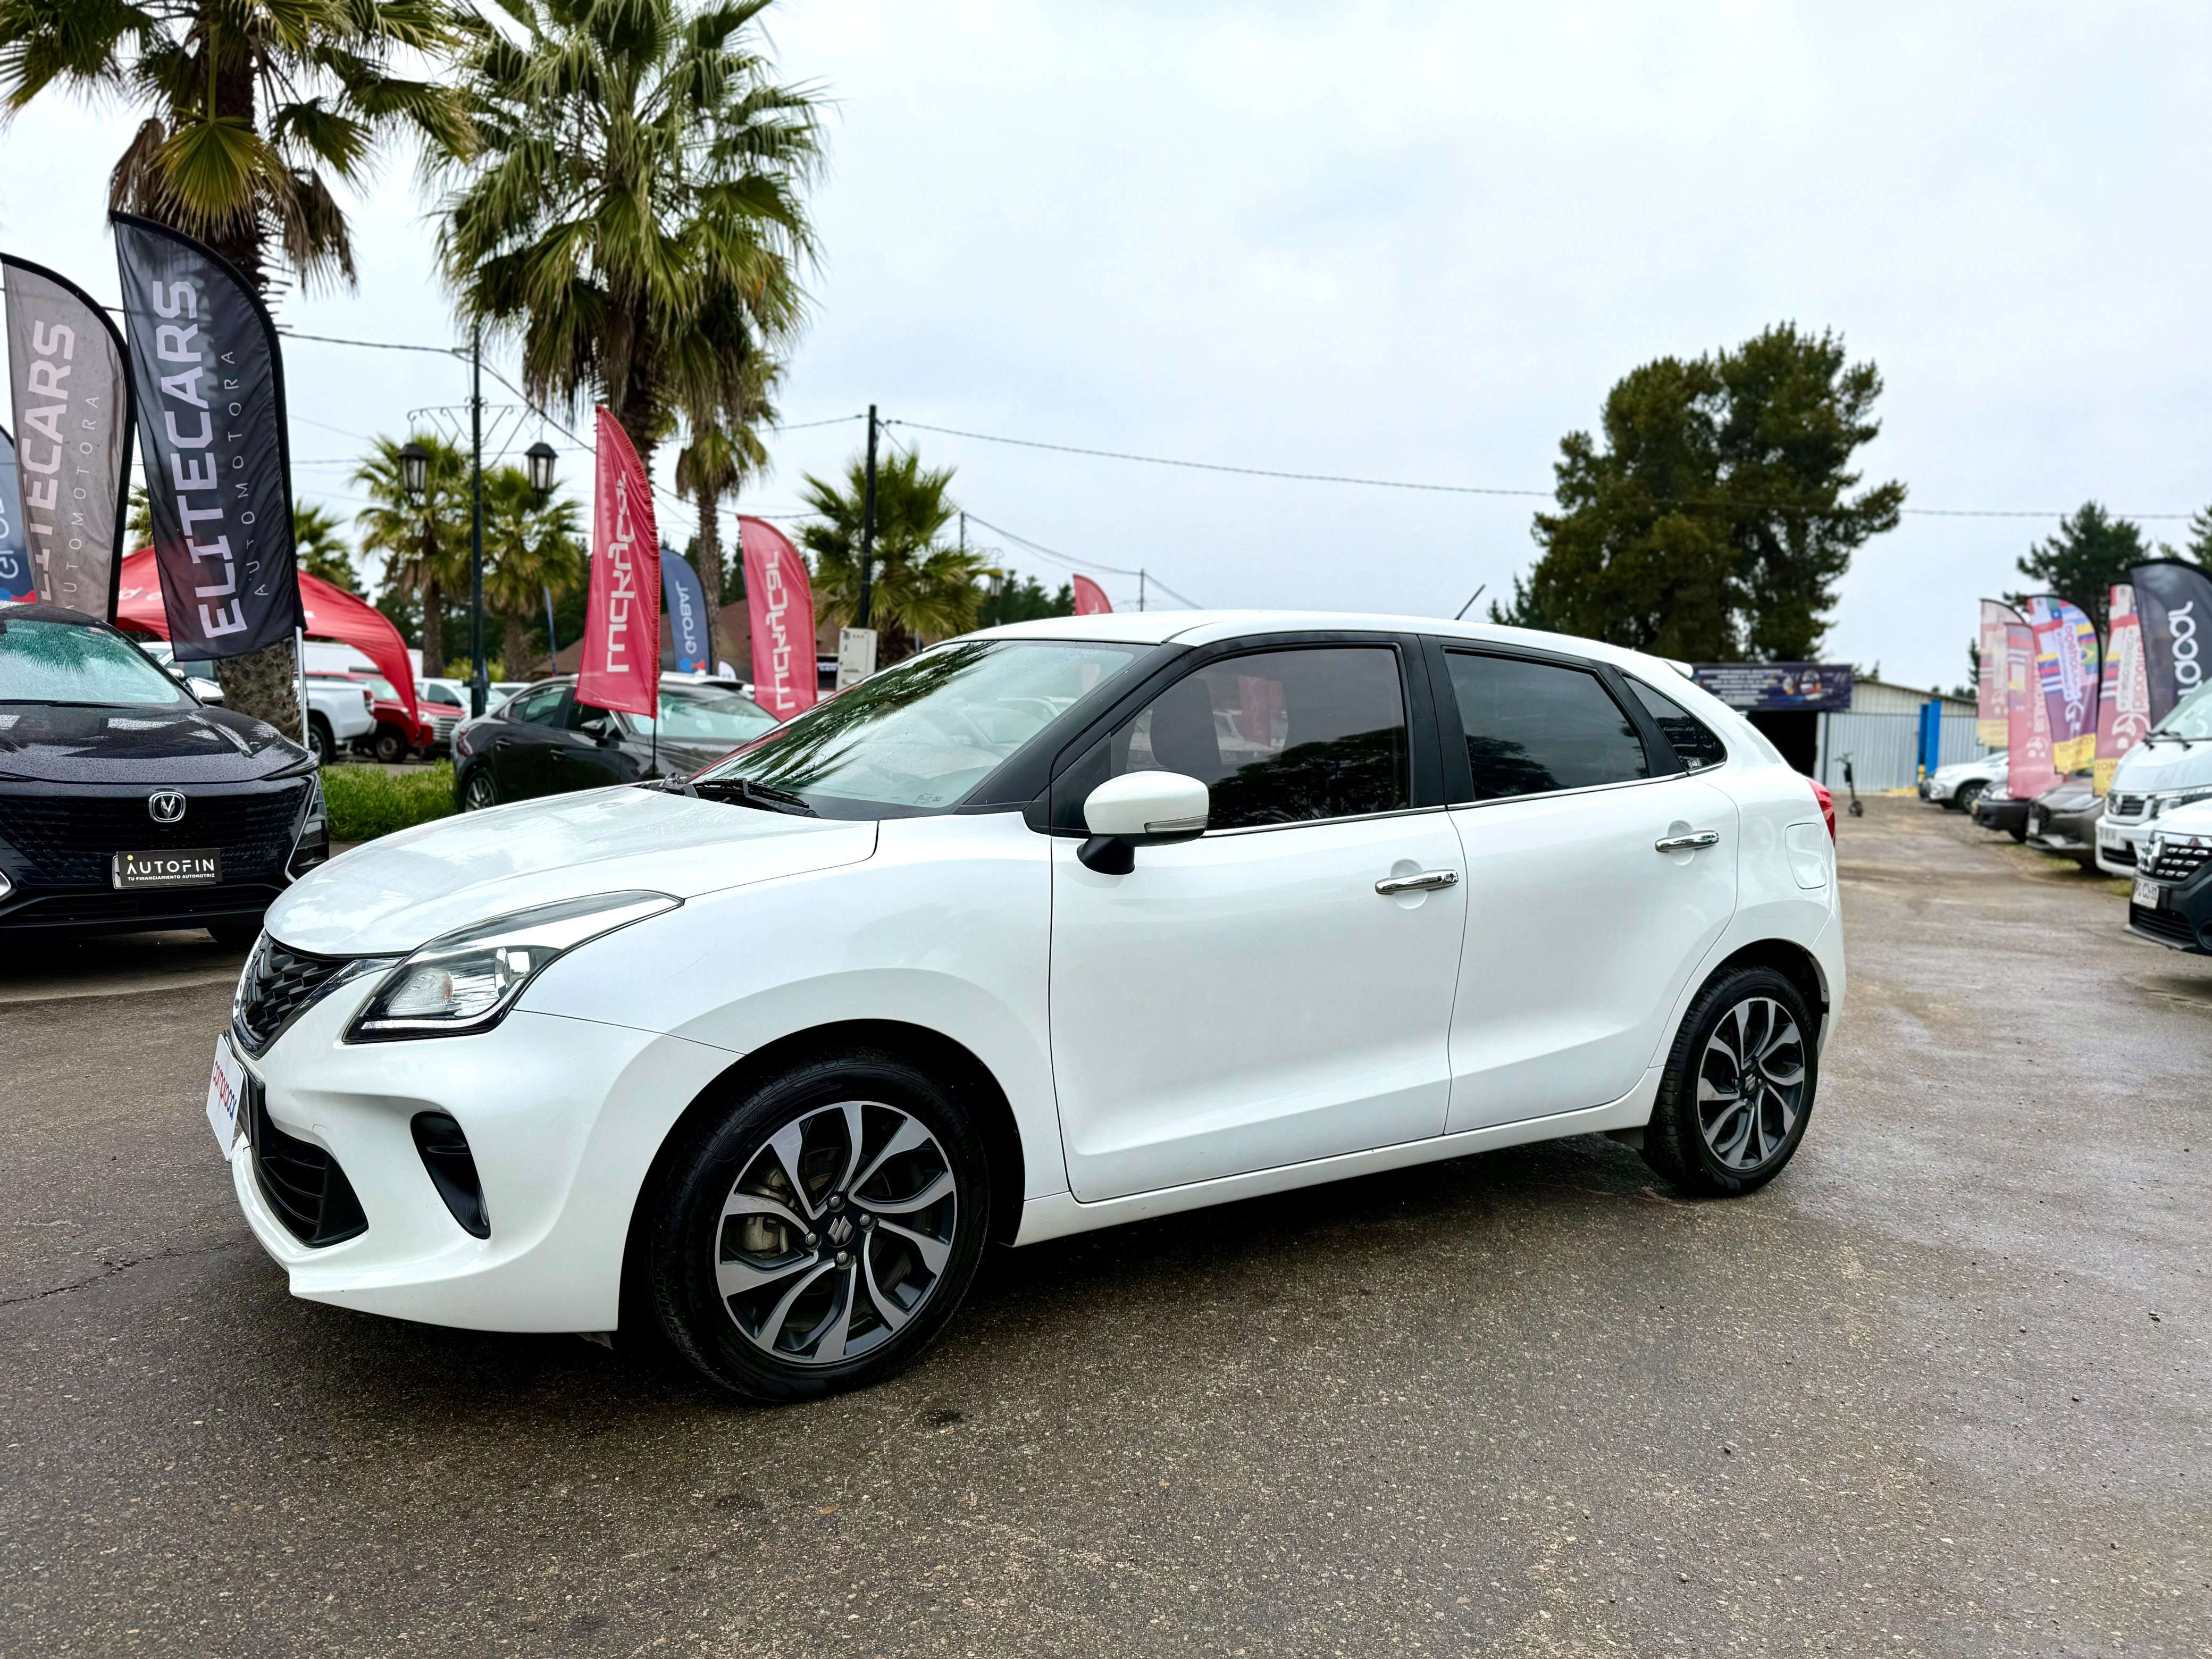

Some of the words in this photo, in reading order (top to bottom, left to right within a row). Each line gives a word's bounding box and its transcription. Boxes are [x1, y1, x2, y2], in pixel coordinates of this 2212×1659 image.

[153, 281, 248, 638] ELITECARS
[221, 351, 269, 596] AUTOMOTORA
[127, 859, 214, 875] AUTOFIN
[213, 1060, 237, 1121] compracar
